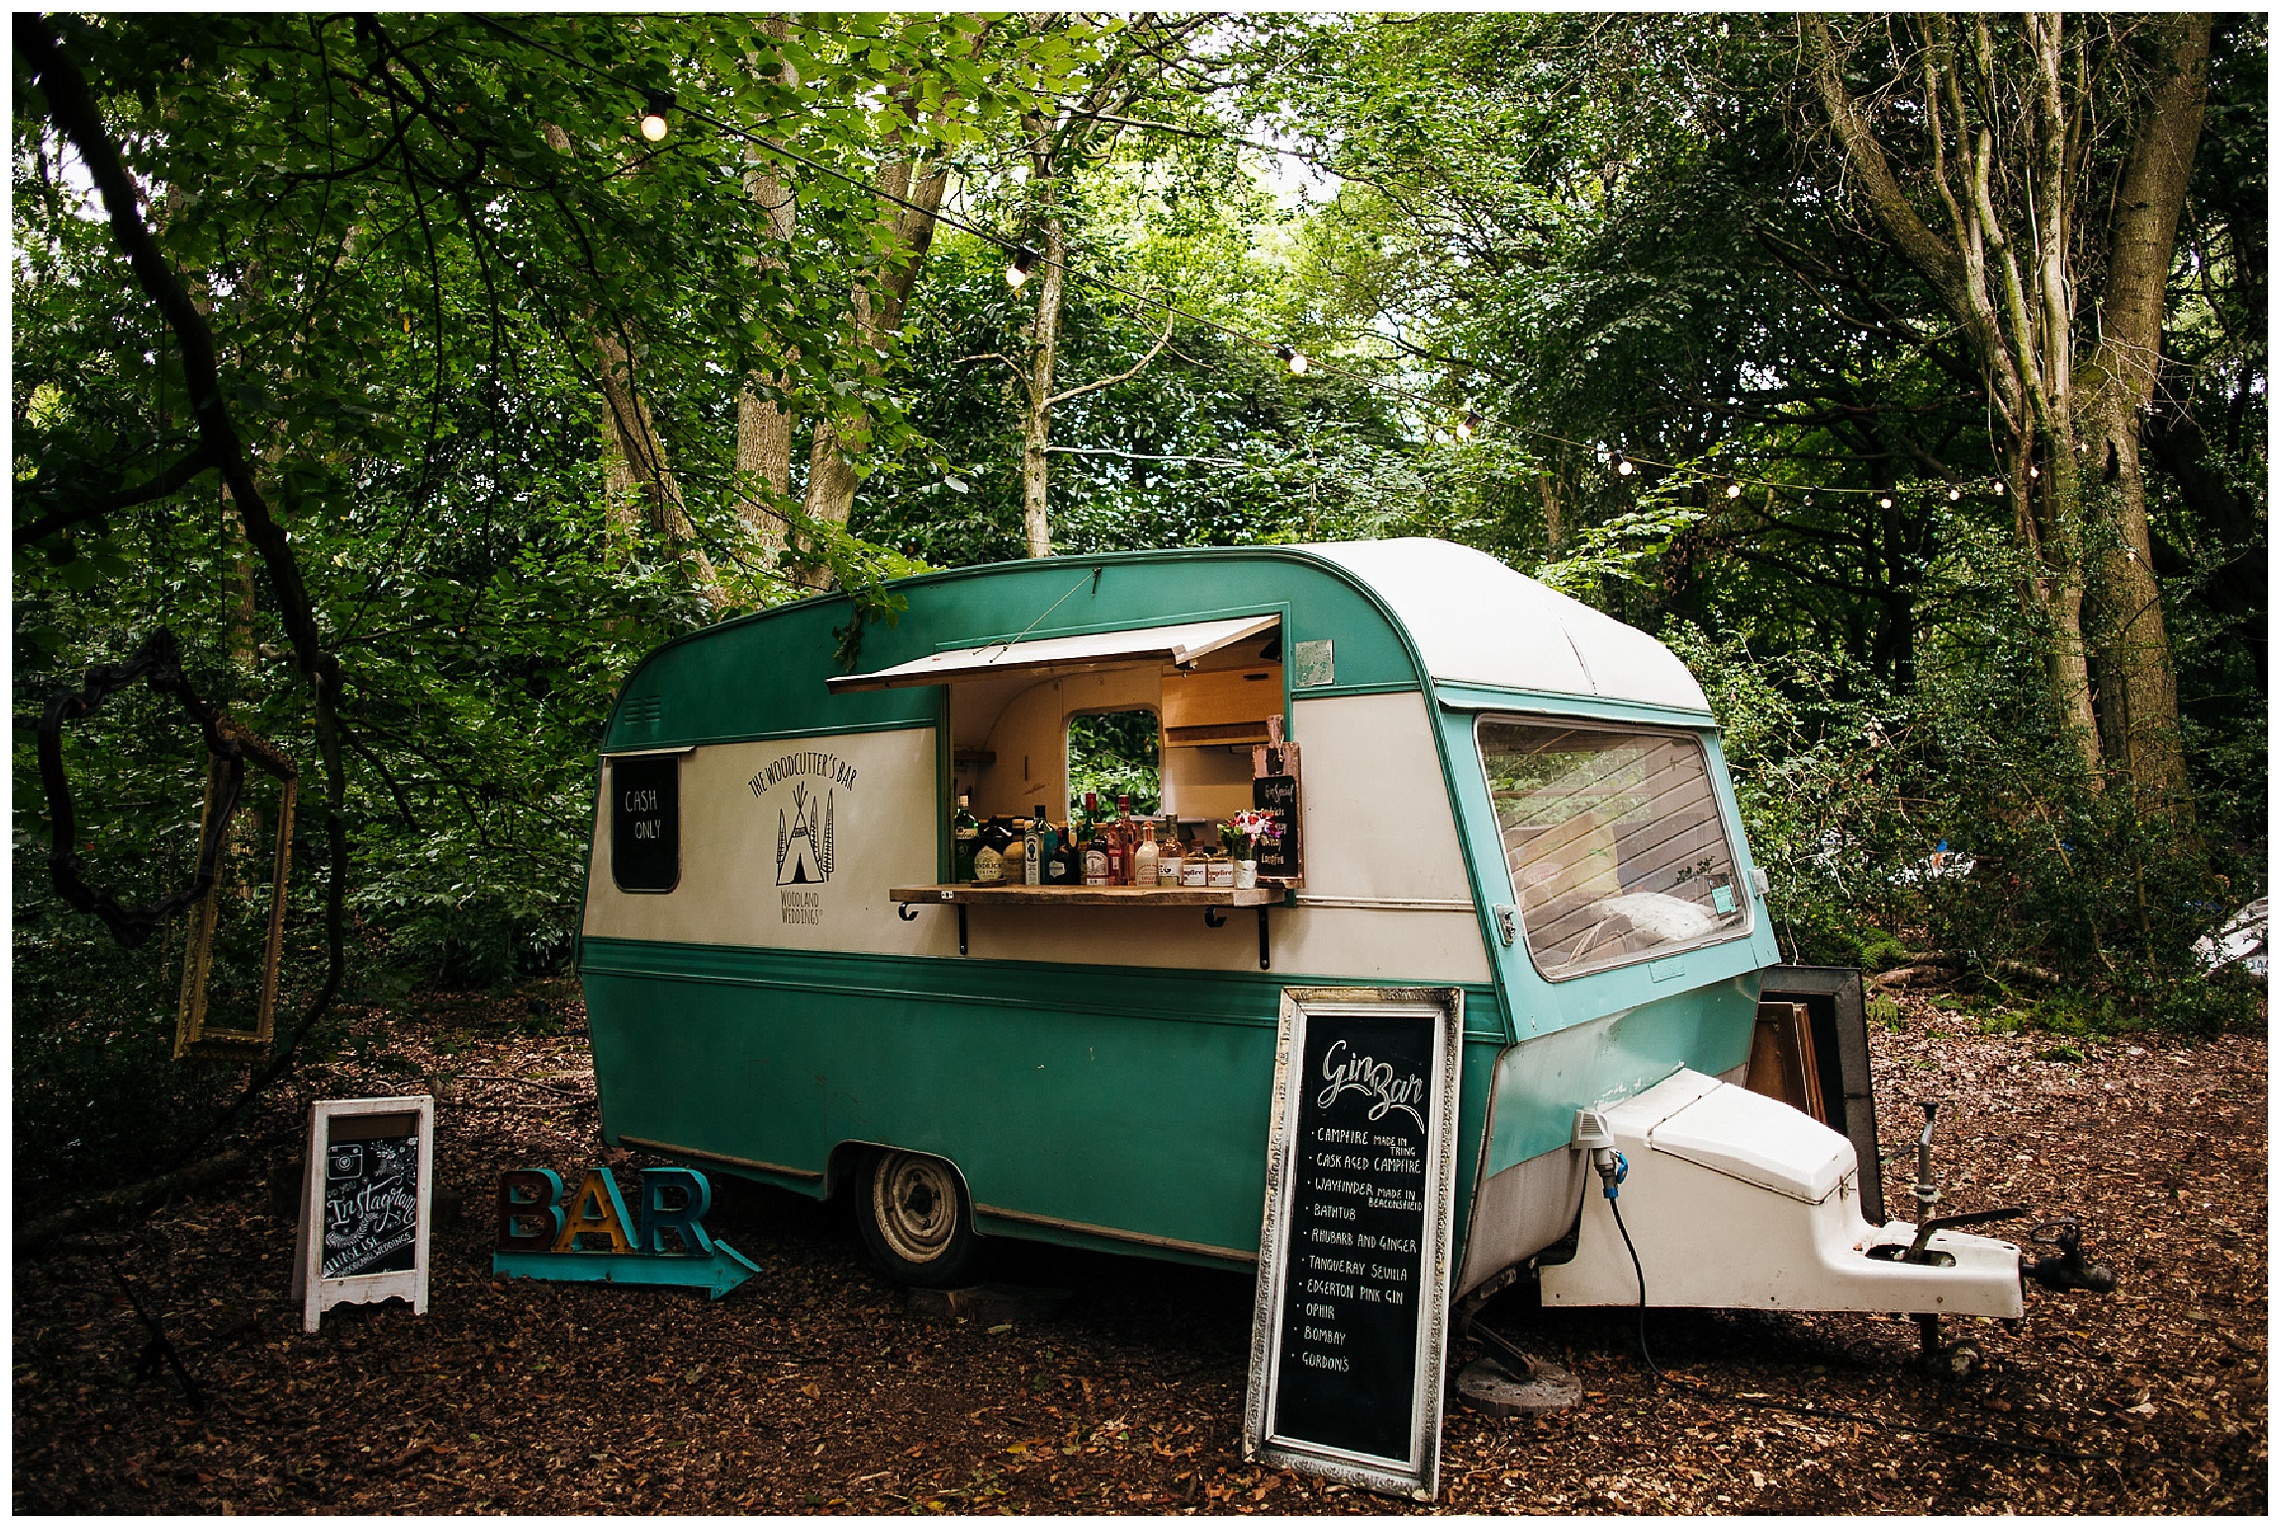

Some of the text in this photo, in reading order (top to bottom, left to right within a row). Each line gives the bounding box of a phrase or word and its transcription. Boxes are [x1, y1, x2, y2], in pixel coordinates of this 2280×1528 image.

[747, 752, 857, 799] THE WOODCUTTER'S BAR
[625, 790, 658, 812] CASH
[635, 819, 661, 839] ONLY
[780, 889, 819, 908] WOODLAND
[781, 906, 819, 926] WEDDINGS
[1317, 1040, 1424, 1121] Gin Bar
[1317, 1128, 1407, 1148] CAMPFIRE MADE IN
[1316, 1153, 1421, 1174] CASK AGED CAMPFIRE
[1315, 1178, 1416, 1201] WAYFINDER MADE IN
[326, 1184, 416, 1233] Instagram
[500, 1167, 715, 1257] BAR
[1314, 1204, 1356, 1221] BATHTUB
[1311, 1228, 1417, 1253] RHUBARB AND GINGER
[1309, 1255, 1407, 1281] TANQUERAY SEVILLA
[1306, 1279, 1403, 1305] EDGERTON PINK GIN
[1306, 1303, 1335, 1320] OPHIR
[1304, 1326, 1346, 1345] BOMBAY
[1302, 1351, 1349, 1373] GORDON'S
